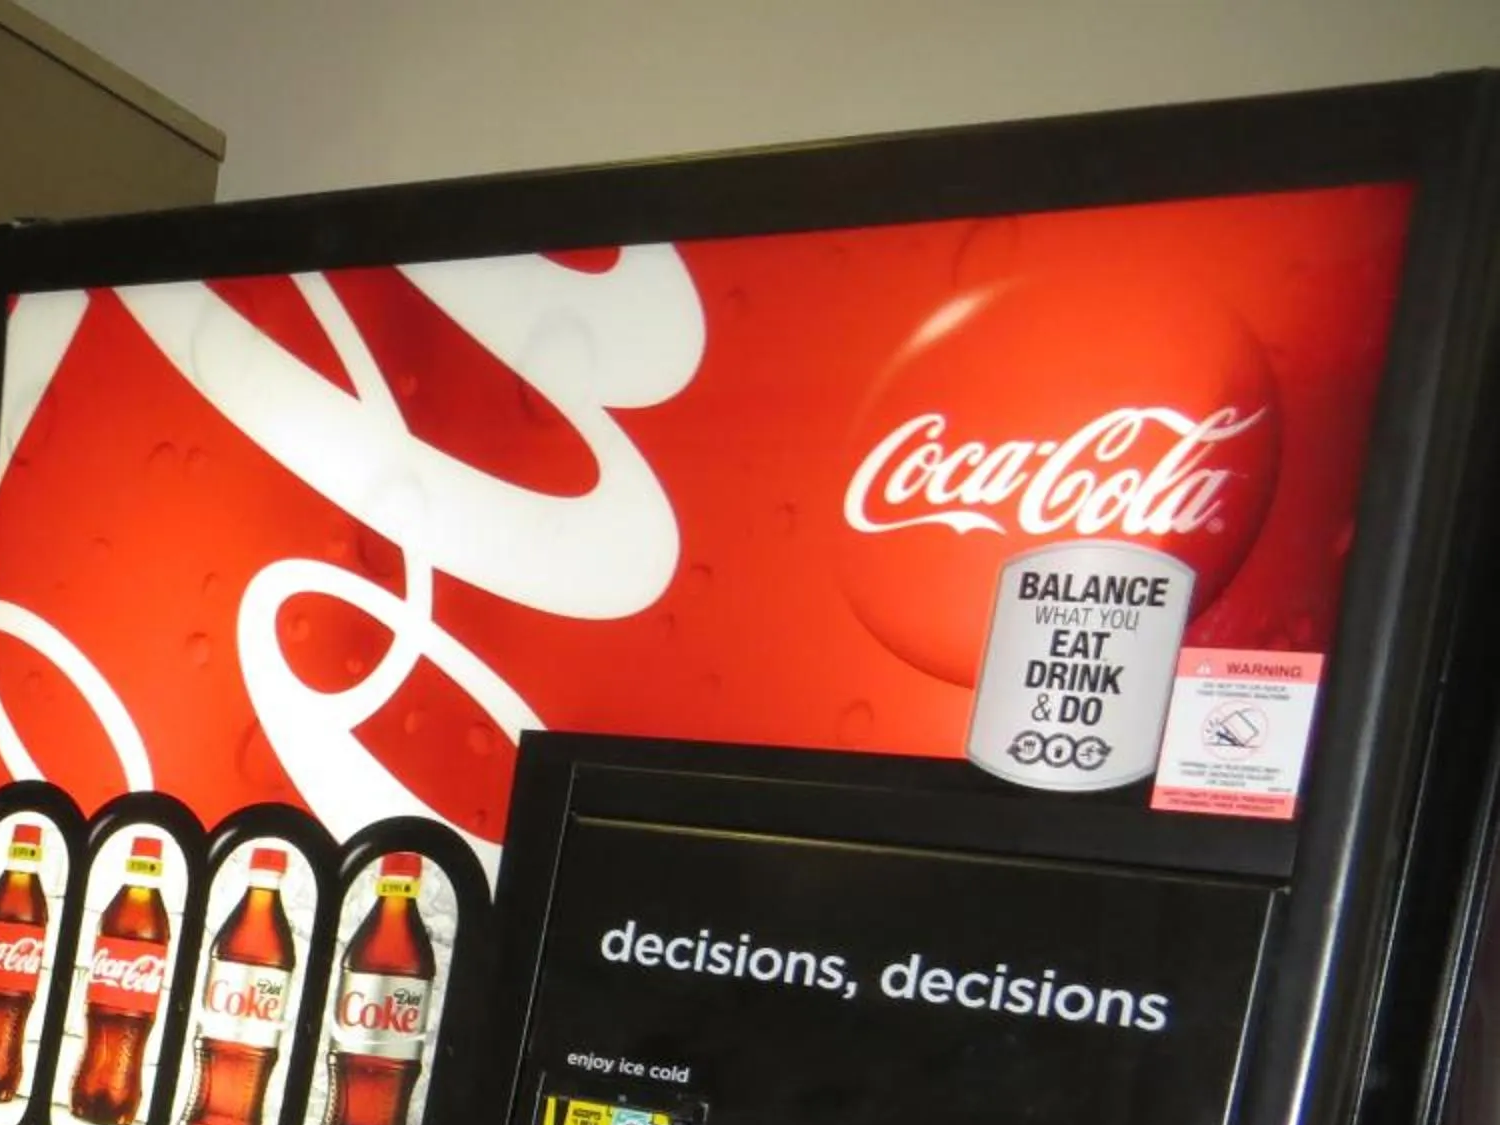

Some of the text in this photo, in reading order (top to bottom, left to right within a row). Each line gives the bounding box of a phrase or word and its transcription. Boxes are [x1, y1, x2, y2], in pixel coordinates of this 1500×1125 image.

[844, 406, 1268, 536] Coca-Cola
[1018, 572, 1170, 607] BALANCE
[1035, 606, 1140, 631] WHAT YOU
[1025, 660, 1126, 695] DRINK
[1226, 662, 1303, 679] WARNING
[1031, 692, 1103, 727] & DO
[600, 920, 1171, 1032] decisions, decisions
[205, 979, 280, 1022] Coke
[337, 991, 419, 1034] Coke
[567, 1052, 691, 1083] enjoy ice cold
